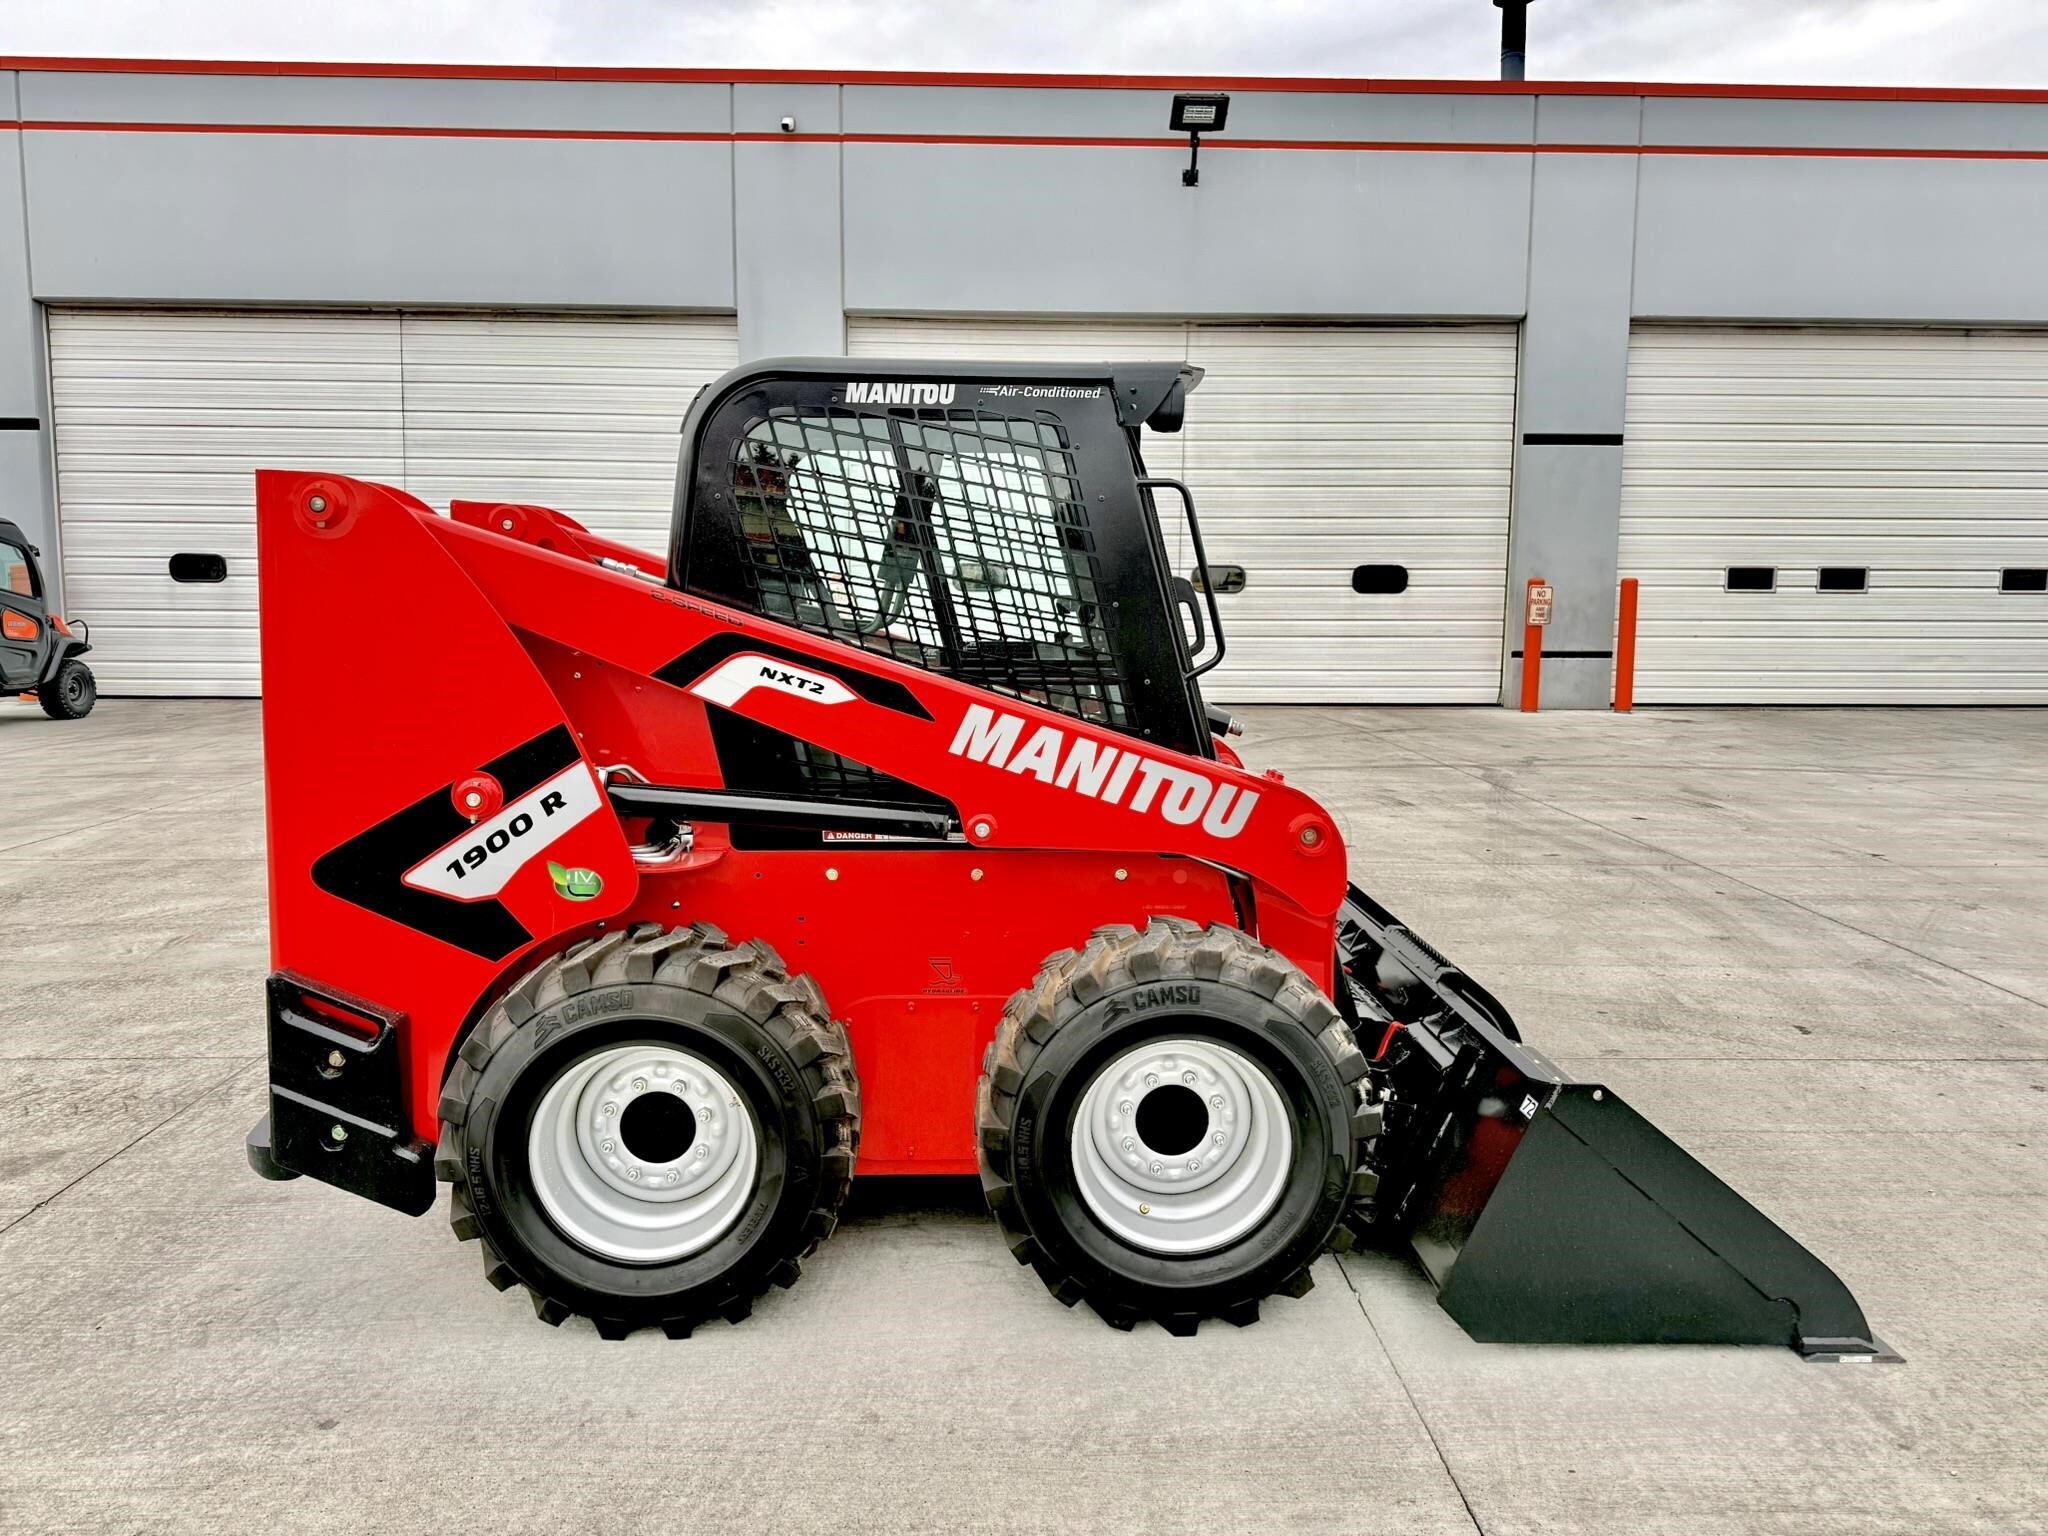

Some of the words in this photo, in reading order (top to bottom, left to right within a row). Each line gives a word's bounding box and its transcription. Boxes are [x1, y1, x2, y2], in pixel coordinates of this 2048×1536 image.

[845, 383, 956, 404] MANITOU
[999, 386, 1101, 400] Air-Conditioned
[1536, 590, 1546, 598] NO
[650, 590, 744, 627] 2-SPEED
[759, 666, 825, 695] NXT2
[948, 703, 1260, 838] MANITOU
[446, 813, 534, 879] 1900
[539, 791, 567, 817] R
[836, 832, 873, 840] DANGER
[561, 989, 634, 1024] CAMSO
[1131, 985, 1201, 1011] CAMSO
[757, 1045, 780, 1070] SKS
[774, 1067, 796, 1093] 532
[1522, 1097, 1537, 1117] 72
[469, 1146, 481, 1173] NHS
